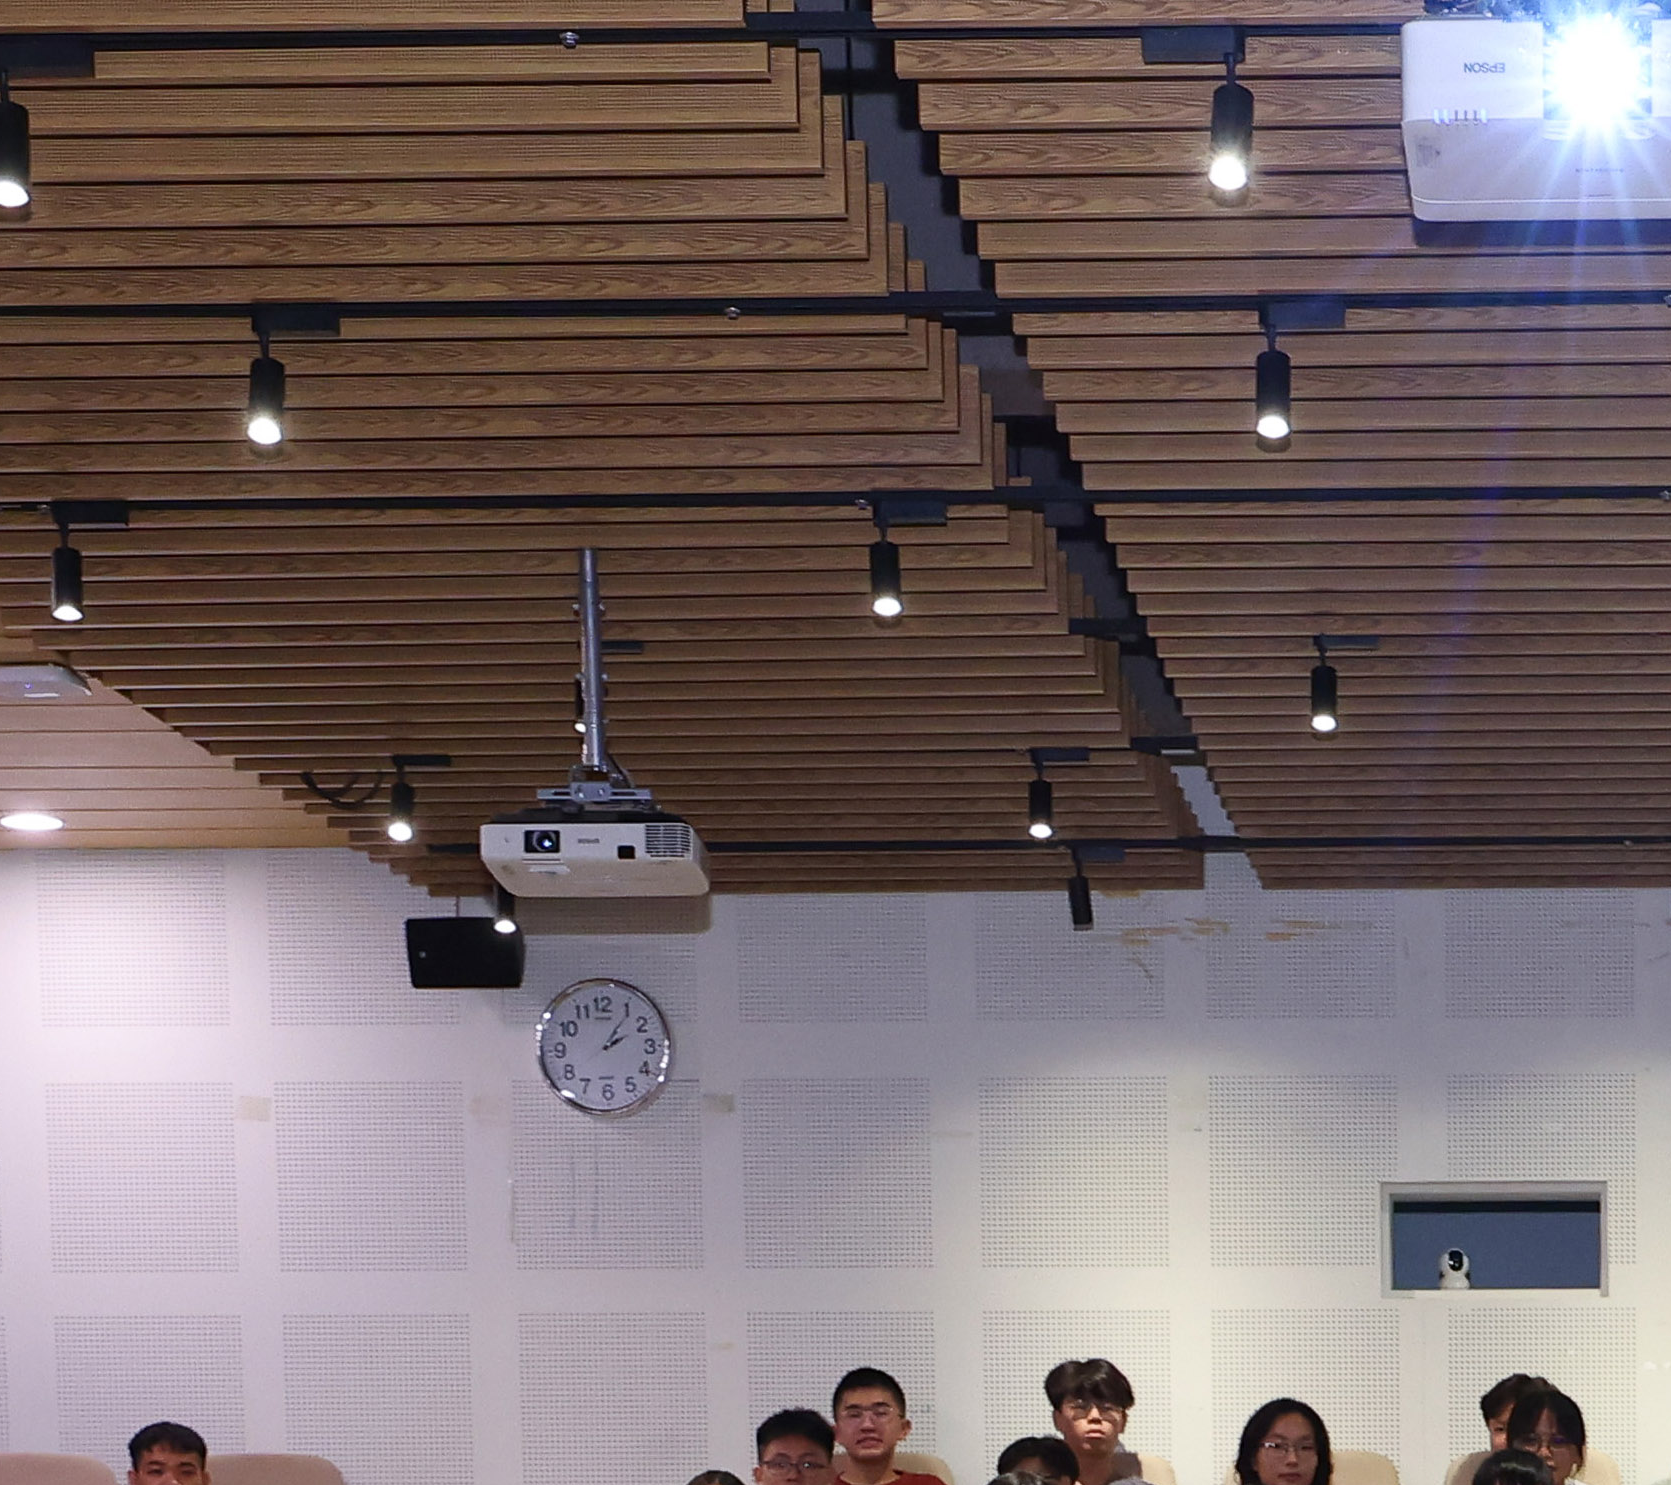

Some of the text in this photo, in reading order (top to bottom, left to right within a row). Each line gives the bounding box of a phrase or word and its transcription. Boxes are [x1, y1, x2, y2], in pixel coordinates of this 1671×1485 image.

[1463, 62, 1506, 73] EPSON
[576, 1004, 589, 1019] 11
[594, 996, 611, 1013] 12
[624, 1003, 630, 1017] 1
[560, 1020, 578, 1037] 10
[637, 1017, 648, 1032] 2
[555, 1041, 566, 1058] 9
[644, 1039, 656, 1054] 3
[563, 1064, 575, 1080] 8
[639, 1061, 651, 1076] 4
[579, 1078, 591, 1094] 7
[602, 1084, 614, 1101] 6
[624, 1076, 637, 1093] 5
